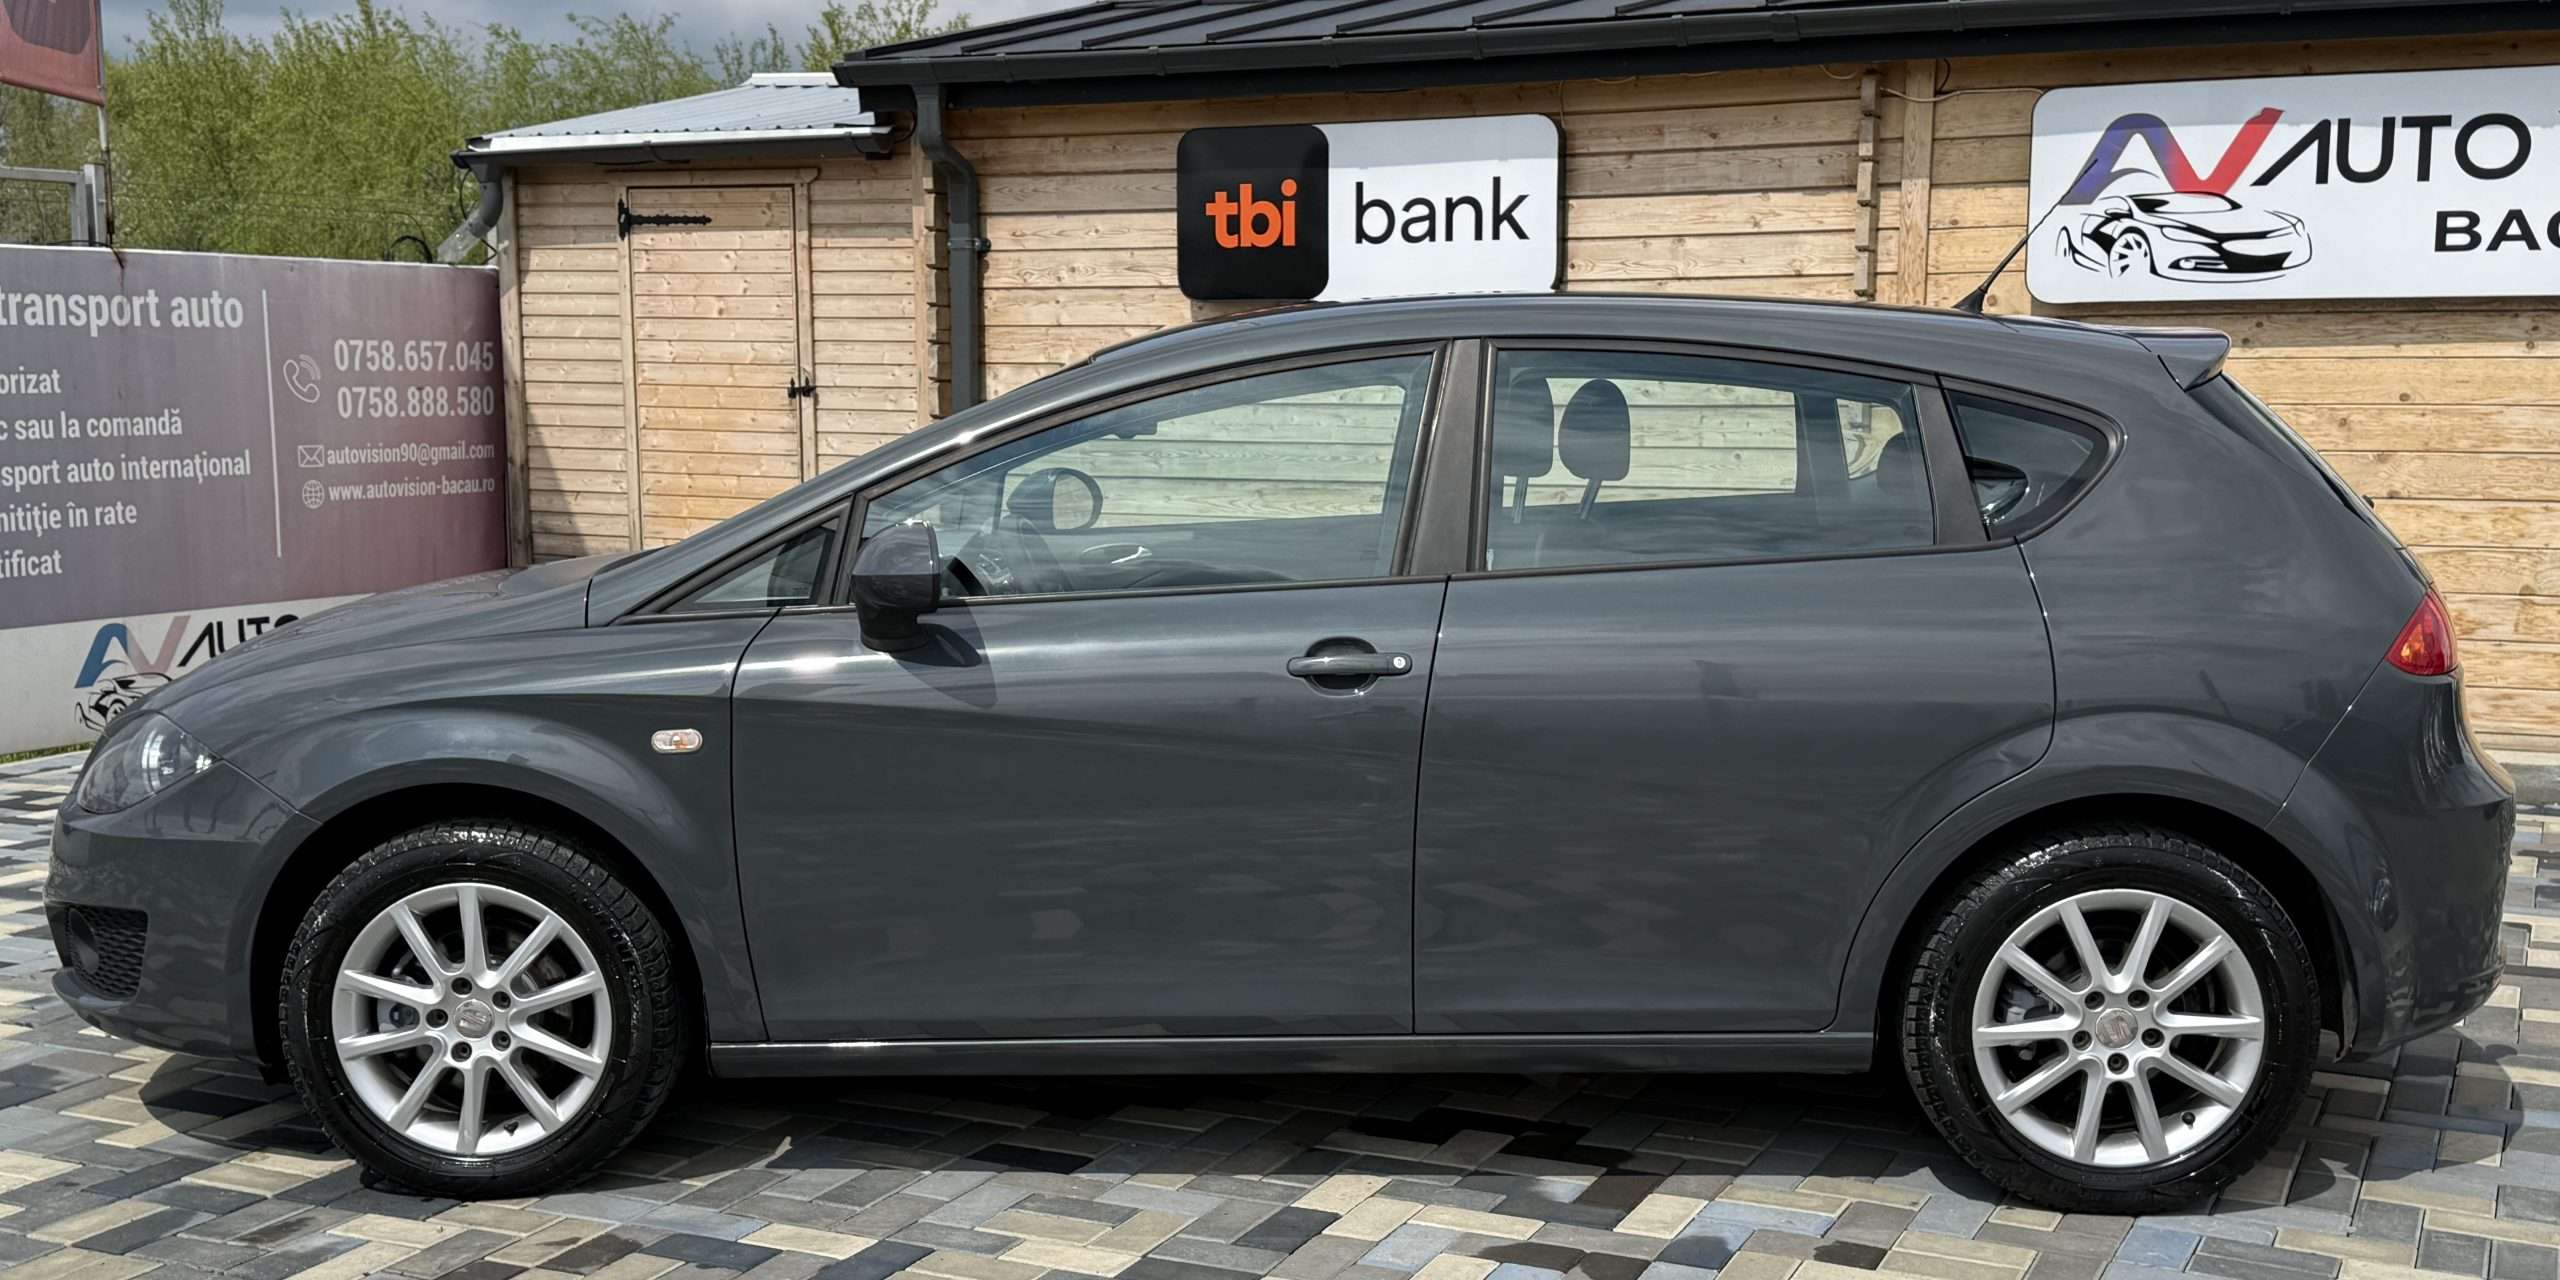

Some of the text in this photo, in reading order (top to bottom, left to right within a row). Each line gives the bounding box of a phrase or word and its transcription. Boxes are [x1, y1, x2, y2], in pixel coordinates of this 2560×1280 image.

[2250, 112, 2532, 187] AUTO
[1205, 175, 1530, 249] tbi bank
[2434, 208, 2560, 252] BA
[170, 289, 244, 328] auto
[333, 338, 494, 372] 0758.657.045
[0, 365, 62, 395] orizat
[336, 385, 495, 419] 0758.888.580
[14, 418, 55, 440] sau
[60, 410, 81, 438] la
[86, 407, 183, 438] comandă
[326, 440, 495, 466] autovision90@gmail.com
[0, 459, 61, 493] sport
[66, 458, 115, 484] auto
[328, 475, 496, 501] www.autovision-bacau.ro
[66, 500, 89, 529] în
[94, 500, 138, 526] rate
[177, 613, 299, 667] AUT
